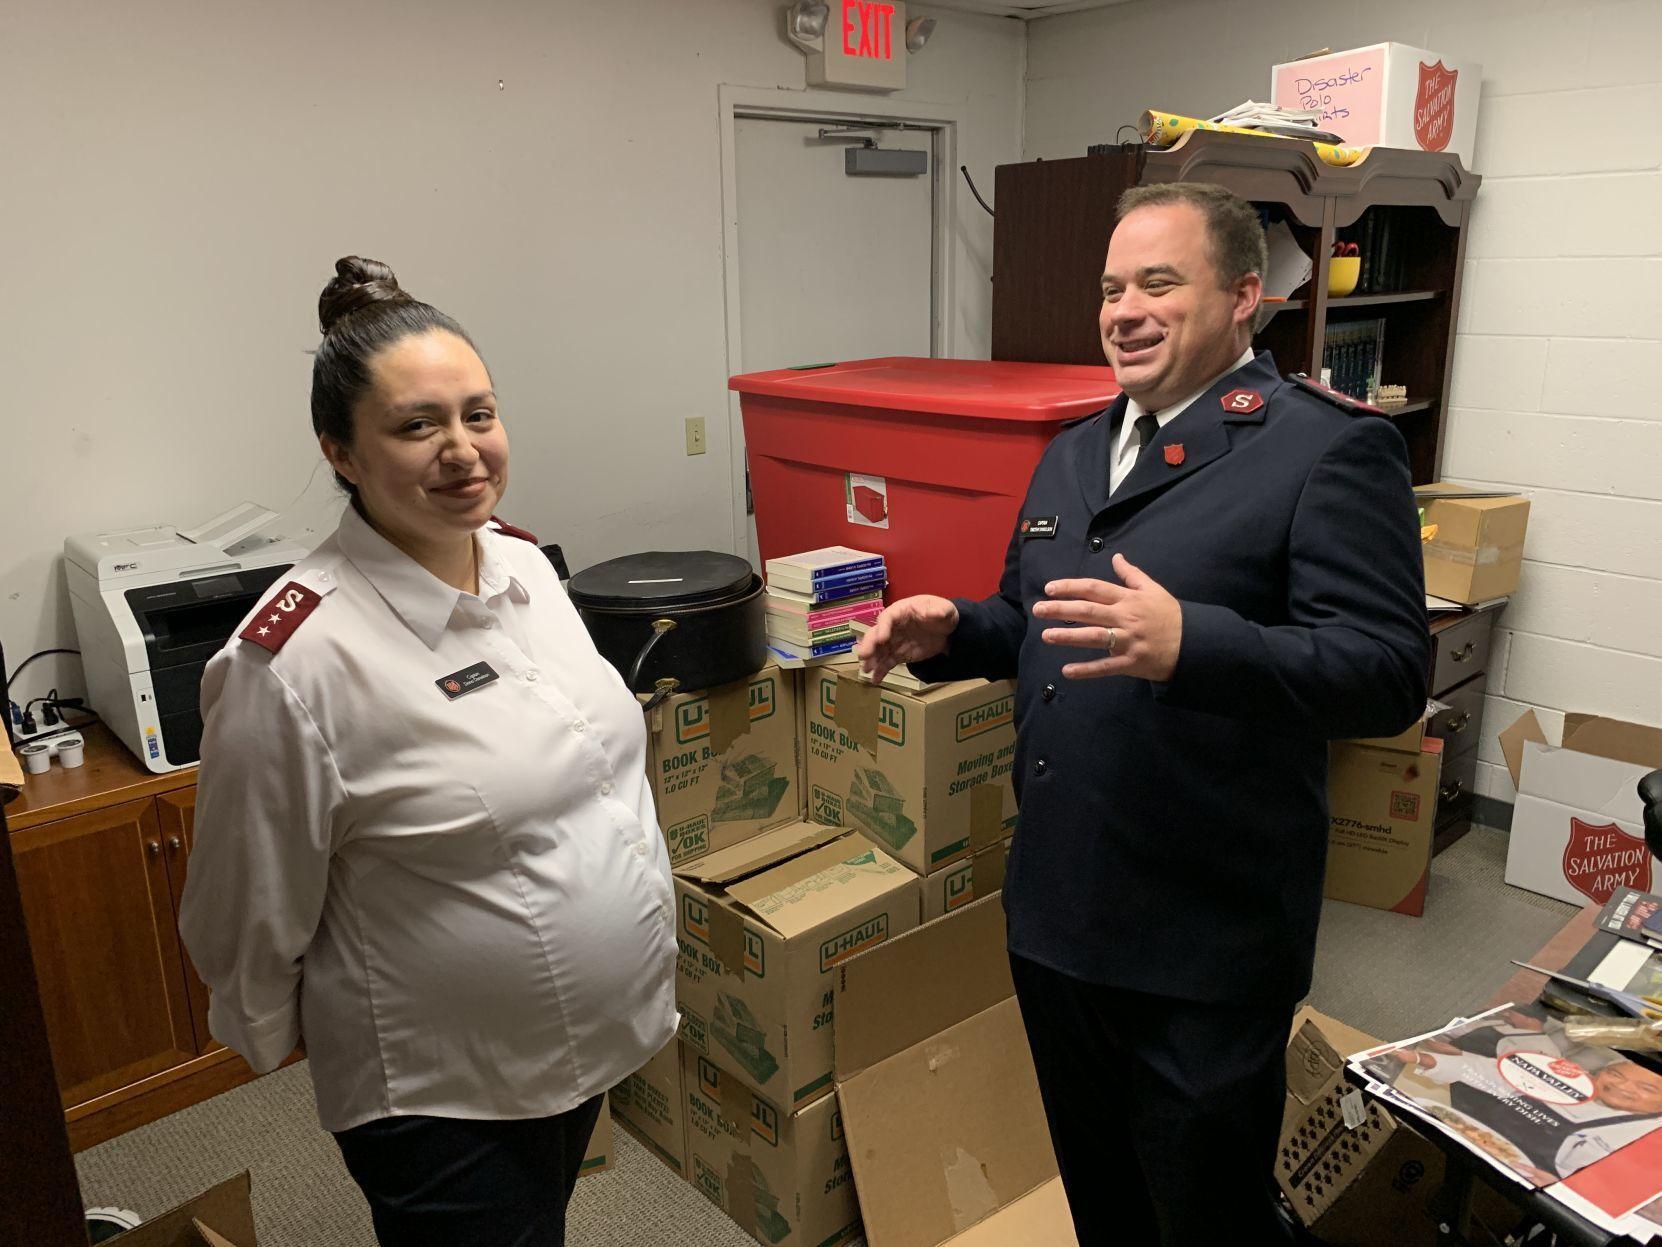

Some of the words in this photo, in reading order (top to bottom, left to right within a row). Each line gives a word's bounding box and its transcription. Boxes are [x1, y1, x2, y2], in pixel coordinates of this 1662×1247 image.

[842, 0, 895, 59] EXIT
[1294, 67, 1371, 95] Disaster
[1425, 72, 1440, 98] THE
[1300, 94, 1332, 110] Polo
[1416, 79, 1453, 130] SALVATION
[1427, 105, 1450, 144] ARMY
[1231, 394, 1253, 408] S
[276, 589, 304, 612] S
[960, 700, 1013, 730] U-HAUL
[810, 721, 836, 744] BOOK
[662, 751, 698, 774] BOOK
[811, 747, 820, 756] 1.0
[820, 751, 829, 760] CU
[829, 755, 837, 764] FT
[957, 754, 994, 777] Moving
[665, 784, 676, 795] 1.0
[677, 779, 689, 790] CU
[689, 776, 700, 787] FT
[948, 770, 988, 796] Storage
[824, 804, 841, 823] OK
[682, 831, 706, 850] OK
[1585, 833, 1617, 852] THE
[1568, 845, 1645, 876] SALVATION
[1592, 867, 1640, 893] ARMY
[825, 919, 884, 960] U-HAUL
[701, 953, 722, 977] BOX
[1511, 1056, 1541, 1076] NAPA
[1542, 1075, 1584, 1100] VALLEY
[689, 1093, 713, 1118] BOOK
[1533, 1106, 1560, 1127] LIVES
